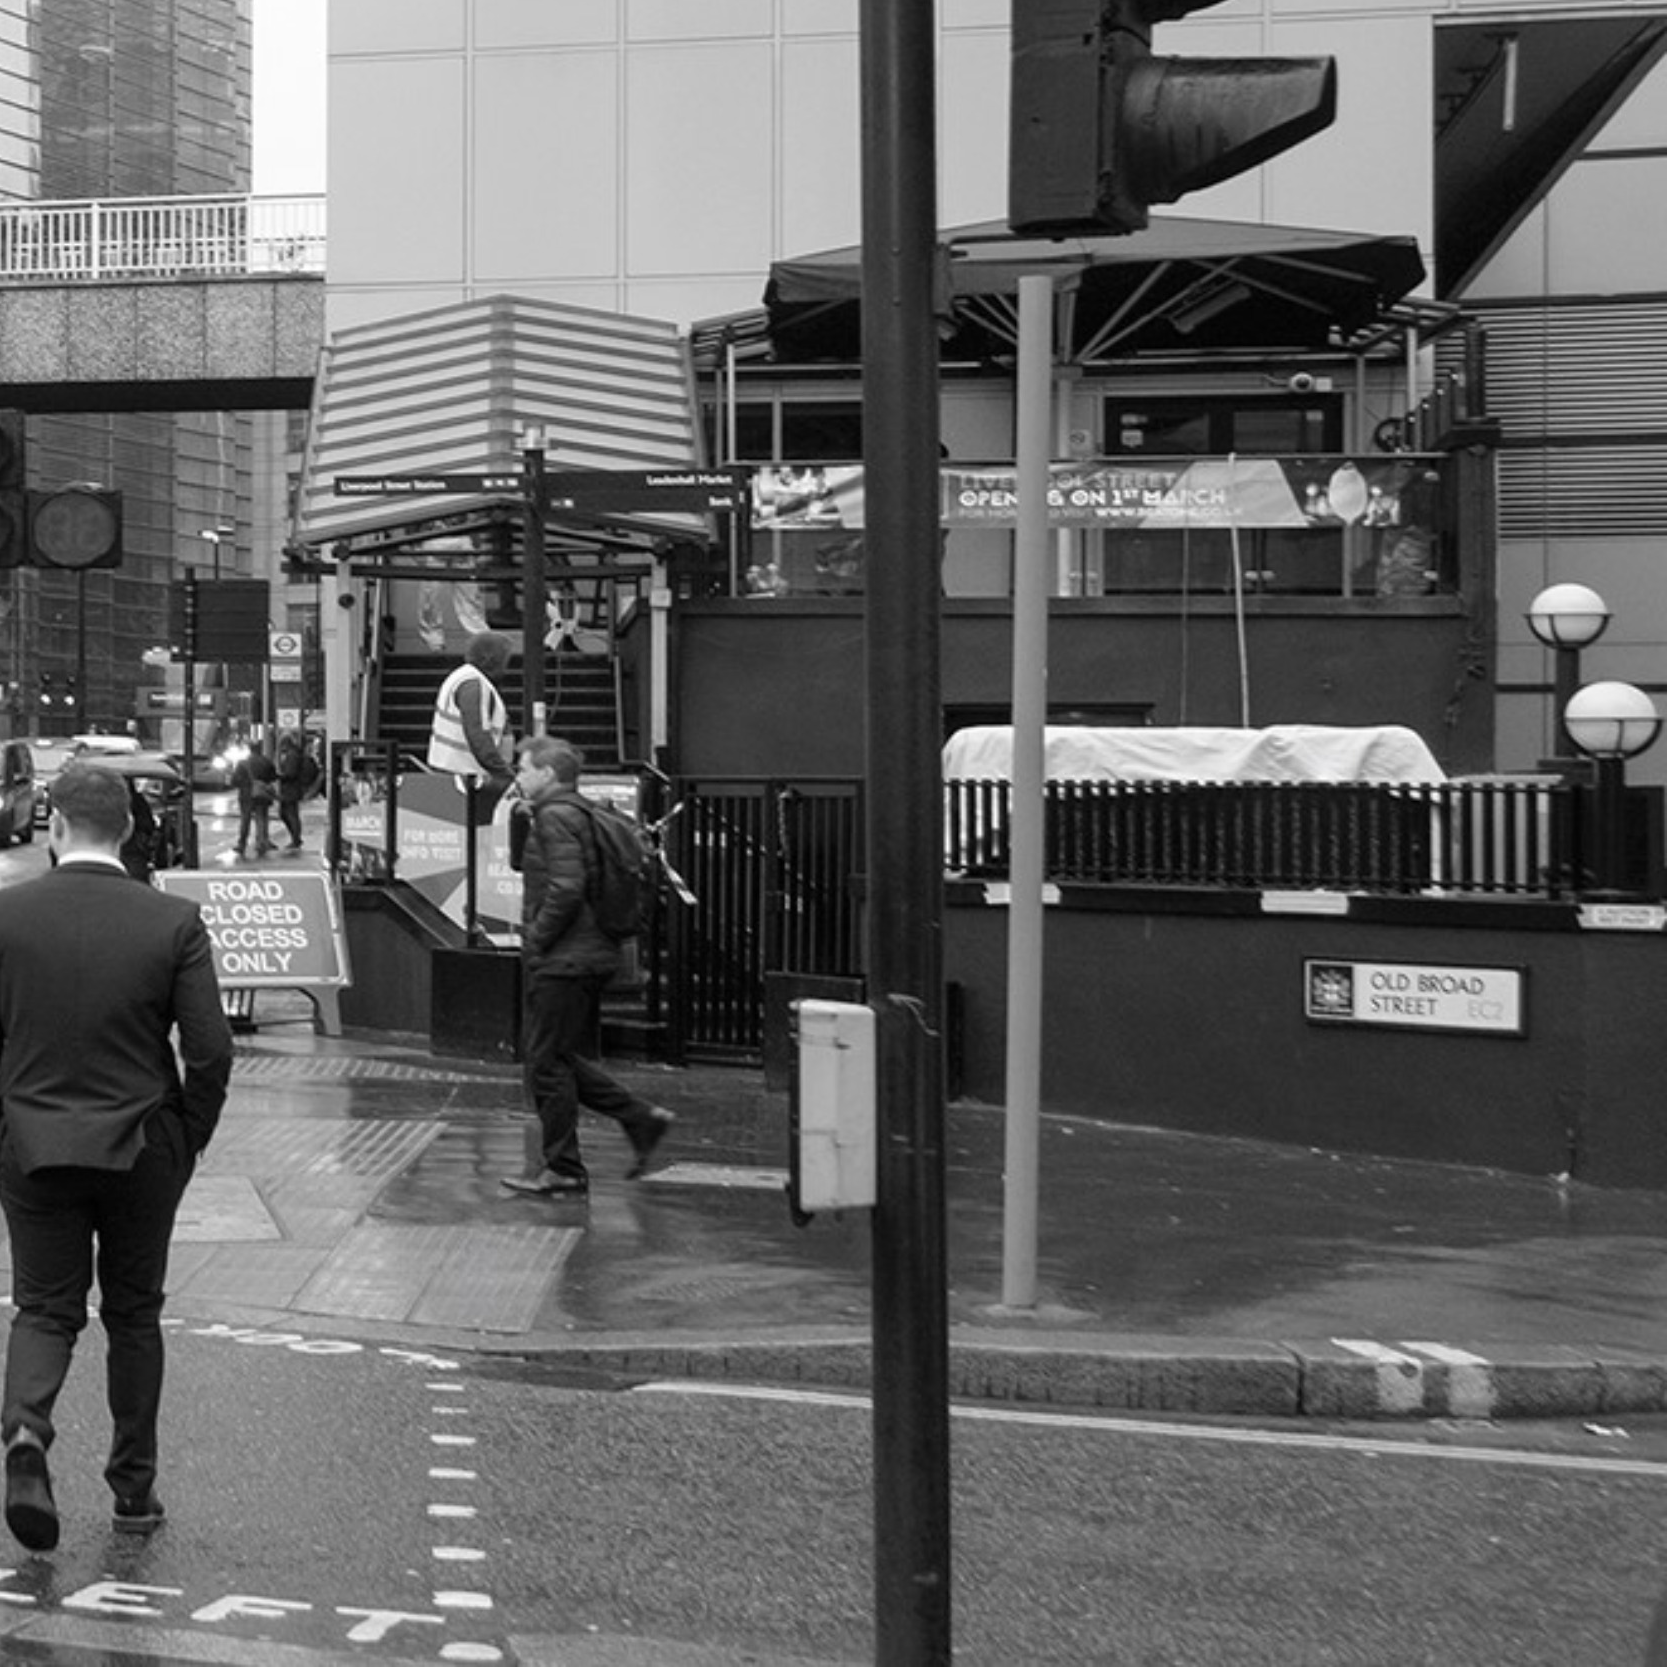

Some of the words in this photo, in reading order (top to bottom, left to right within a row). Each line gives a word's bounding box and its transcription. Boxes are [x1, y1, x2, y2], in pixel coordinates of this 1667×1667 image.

[1070, 489, 1106, 506] ON
[1141, 488, 1227, 505] MARCH
[207, 880, 284, 902] ROAD
[199, 903, 304, 925] CLOSED
[221, 951, 293, 973] ONLY
[1369, 971, 1411, 992] OLD
[1416, 973, 1485, 996] BROAD
[1369, 994, 1438, 1016] STREET
